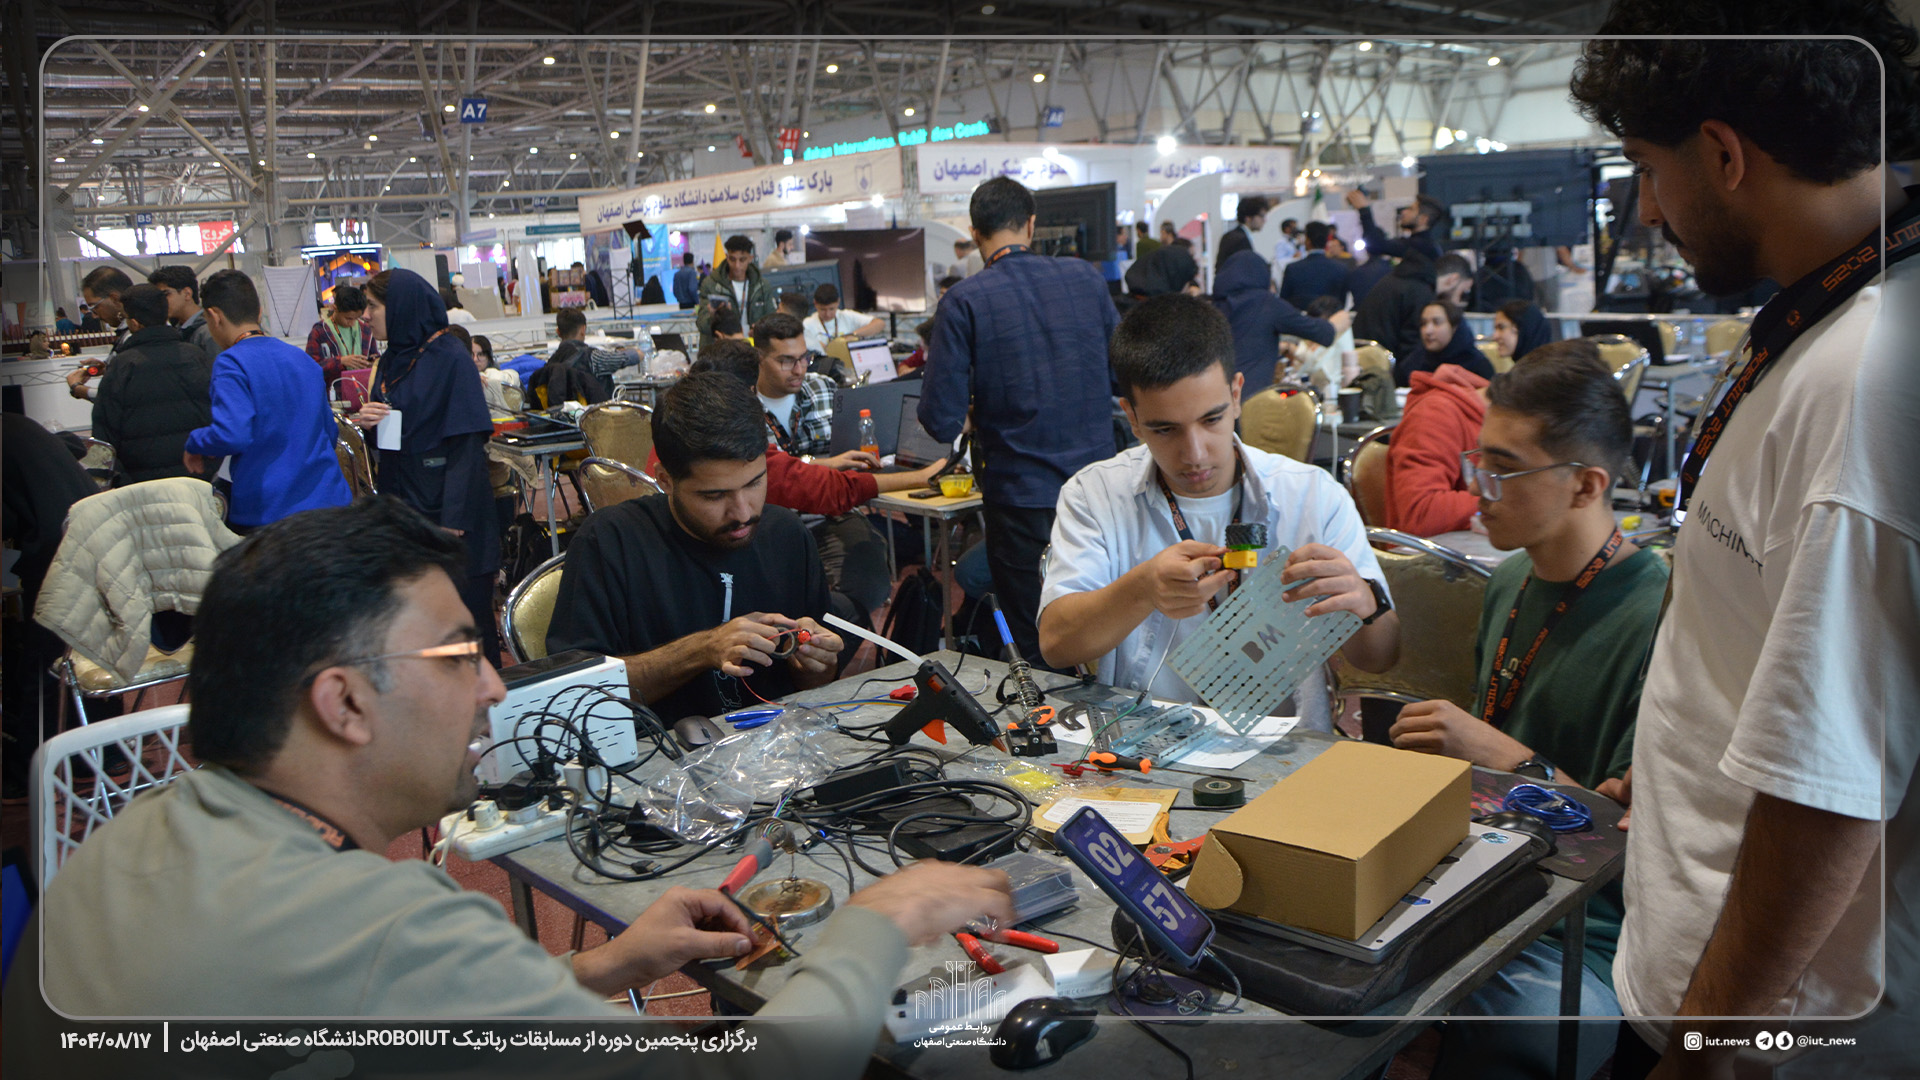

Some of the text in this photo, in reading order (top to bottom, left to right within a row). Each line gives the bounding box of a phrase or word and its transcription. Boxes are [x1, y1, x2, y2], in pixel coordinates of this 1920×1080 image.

[462, 103, 487, 119] A7
[933, 157, 987, 181] اصفهان
[741, 176, 775, 203] فناوری
[807, 169, 833, 194] پارک
[674, 188, 707, 208] دانشگاه
[708, 184, 740, 204] سلامت
[137, 213, 152, 224] B5
[597, 202, 625, 224] اصفهان
[201, 224, 232, 241] خروج
[1821, 245, 1879, 292] 2025
[1088, 831, 1135, 876] 02
[1142, 882, 1187, 931] 57
